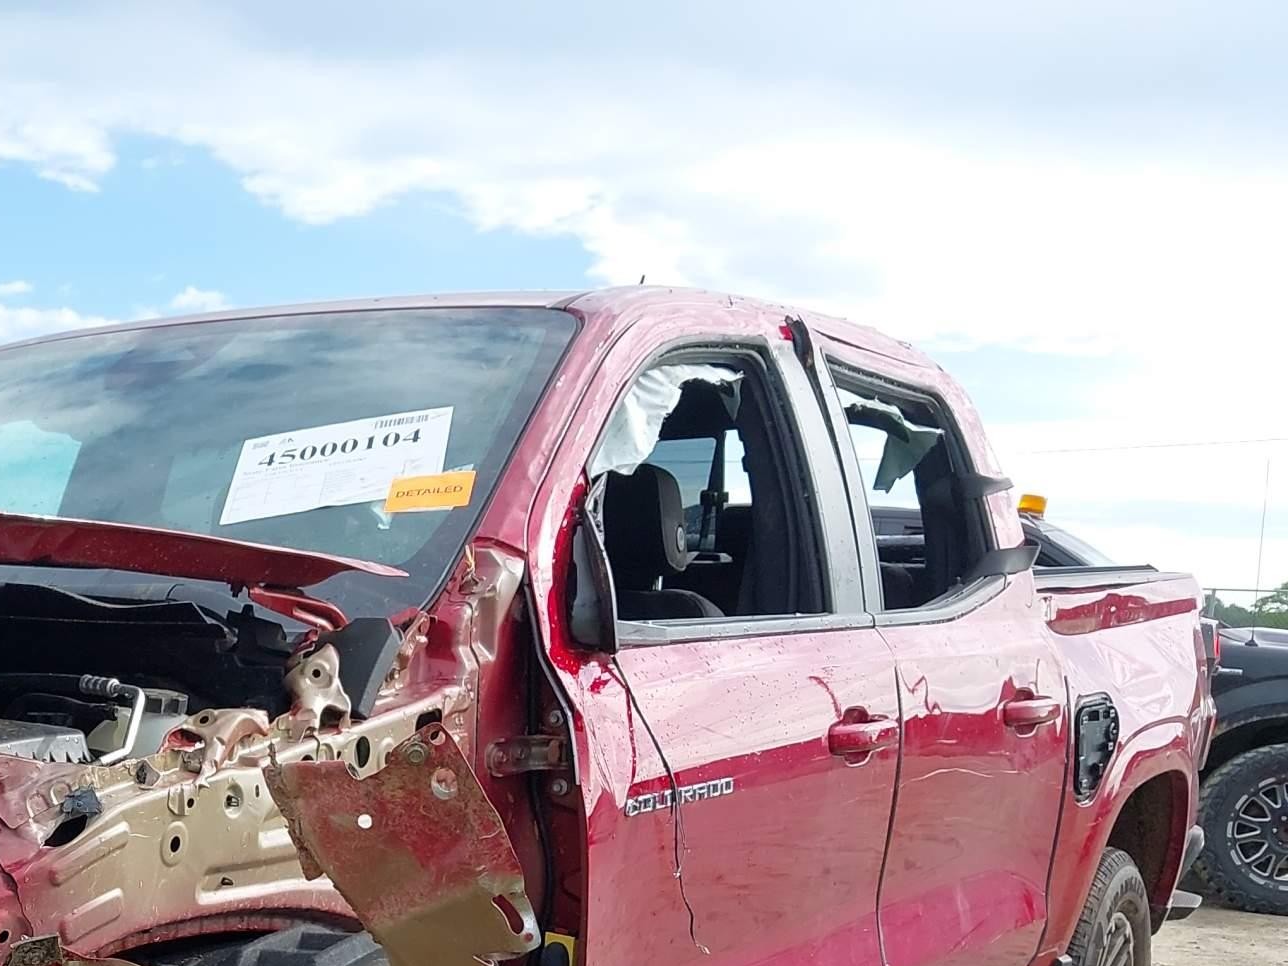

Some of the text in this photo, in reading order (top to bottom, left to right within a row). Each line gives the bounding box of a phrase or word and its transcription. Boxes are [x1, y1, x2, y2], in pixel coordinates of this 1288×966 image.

[257, 427, 423, 468] 45000104
[394, 483, 465, 499] DETAILED
[624, 776, 735, 817] COLORADO
